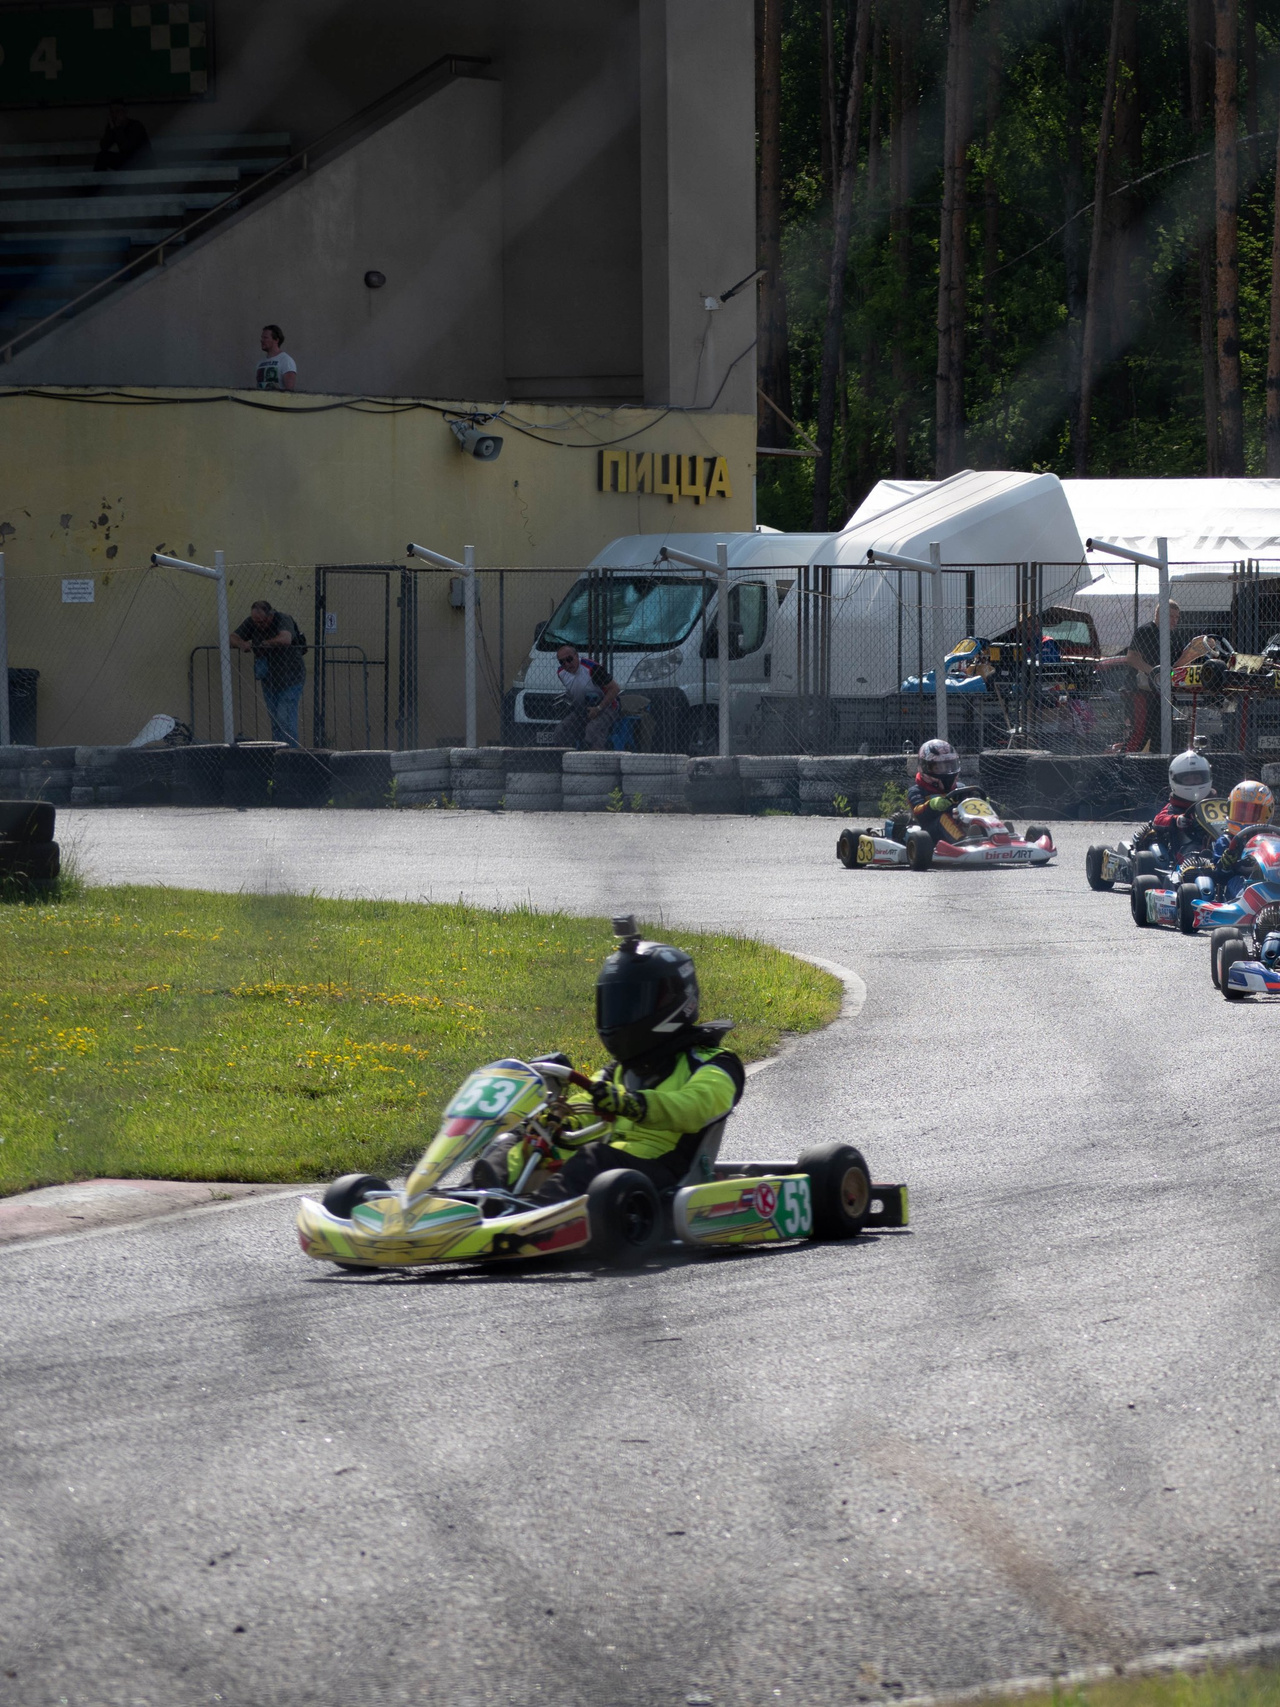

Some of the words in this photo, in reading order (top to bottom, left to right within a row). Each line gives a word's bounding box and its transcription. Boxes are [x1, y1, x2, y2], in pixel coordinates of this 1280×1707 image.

[29, 36, 63, 80] 4
[600, 450, 733, 504] ПИЦЦА
[965, 802, 993, 816] 33
[1204, 803, 1230, 820] 69
[857, 836, 873, 862] 33
[985, 849, 1034, 860] birelART
[456, 1078, 516, 1113] 53
[784, 1180, 811, 1234] 53
